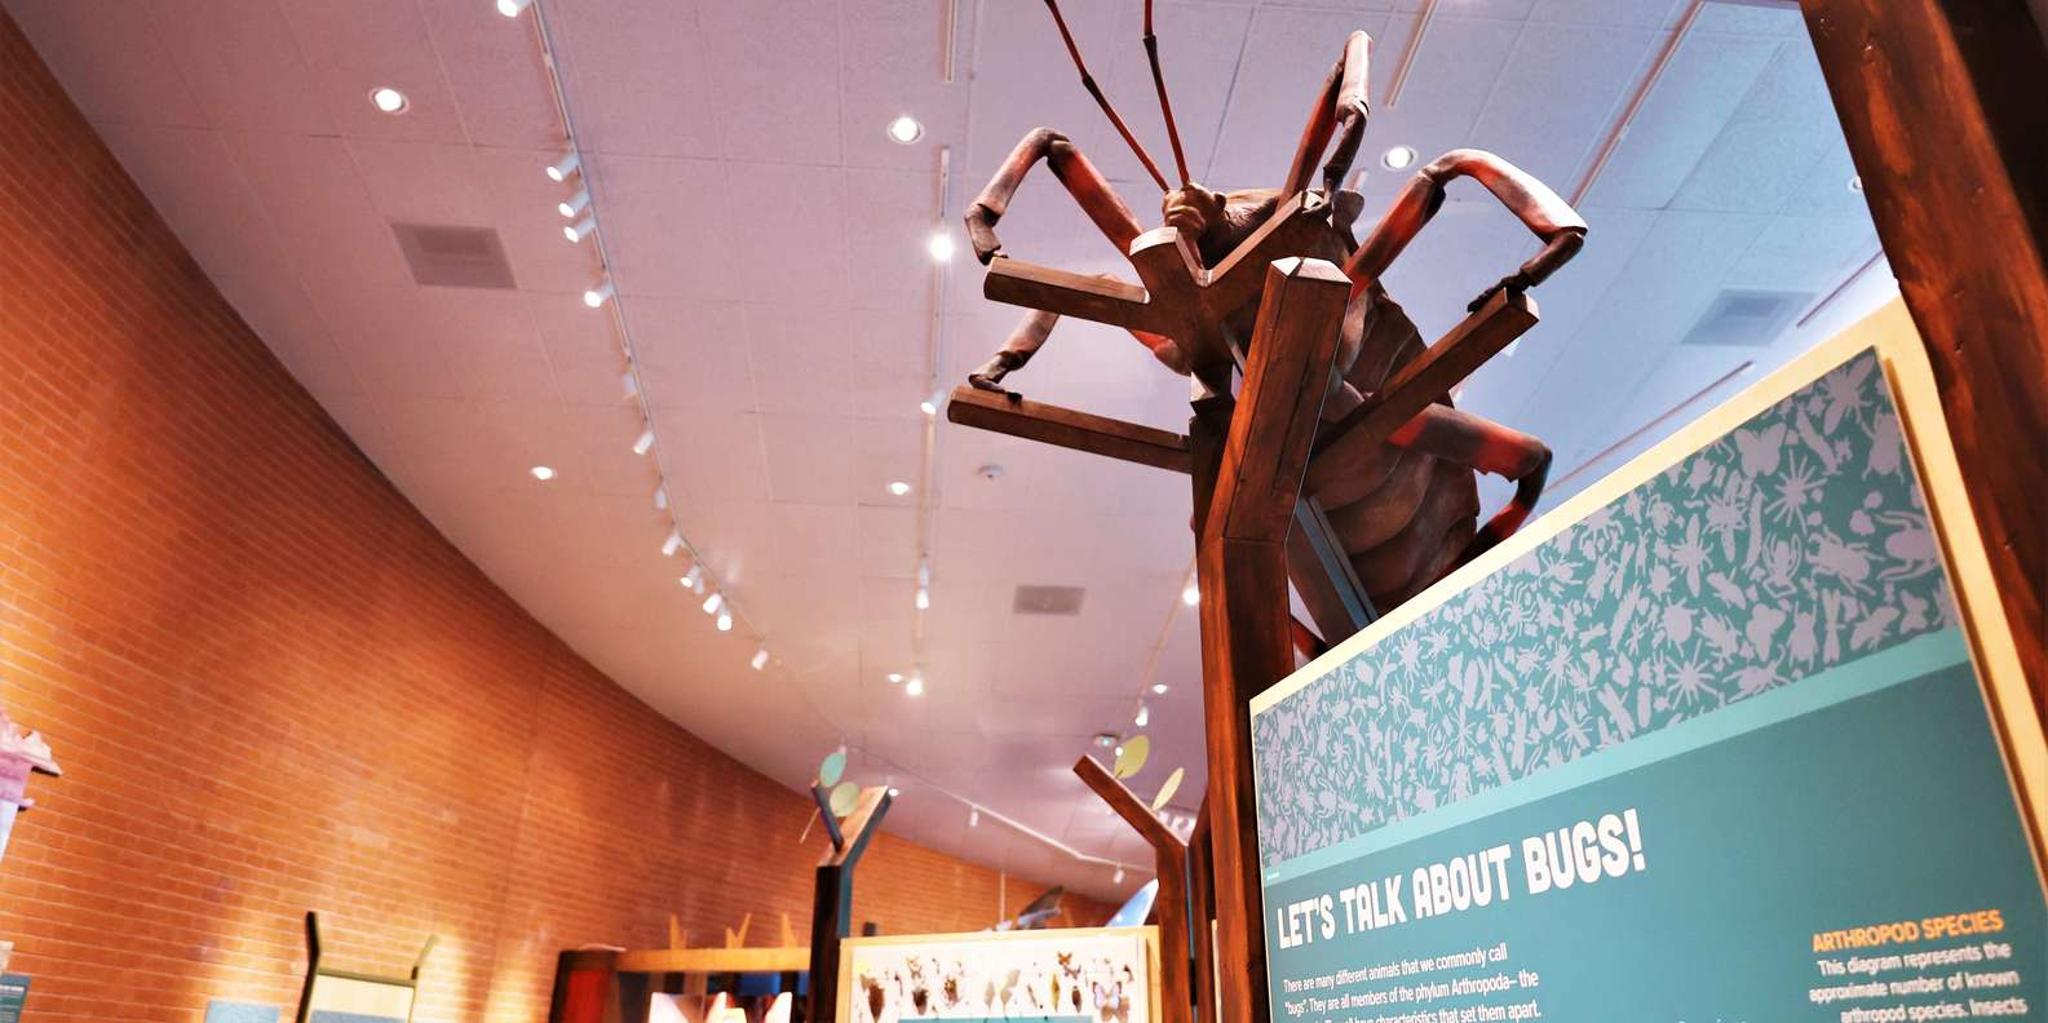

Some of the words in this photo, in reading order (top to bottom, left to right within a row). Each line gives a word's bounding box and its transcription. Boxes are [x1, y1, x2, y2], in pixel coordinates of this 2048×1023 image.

[1277, 894, 1336, 949] LET'S
[1340, 875, 1408, 934] TALK
[1412, 844, 1512, 919] ABOUT
[1522, 808, 1647, 895] BUGS!
[1812, 921, 1920, 952] ARTHROPOD
[1921, 909, 2004, 939] SPECIES
[1283, 978, 1302, 993] There
[1303, 979, 1315, 990] are
[1315, 974, 1335, 990] many
[1335, 967, 1368, 986] different
[1368, 961, 1400, 980] animals
[1400, 958, 1419, 976] that
[1419, 958, 1435, 972] we
[1435, 946, 1487, 969] commonly
[1488, 942, 1508, 962] call
[1816, 958, 1847, 977] This
[1847, 956, 1903, 976] diagram
[1903, 945, 1983, 970] represents
[1983, 941, 2012, 960] the
[1309, 997, 1327, 1015] They
[1327, 998, 1340, 1011] are
[1340, 993, 1350, 1009] all
[1351, 990, 1388, 1007] members
[1389, 987, 1398, 1003] of
[1398, 984, 1414, 1001] the
[1415, 981, 1450, 1004] phylum
[1518, 968, 1540, 988] the
[1808, 981, 1889, 1005] approximate
[1889, 976, 1945, 995] number
[1946, 971, 1963, 991] of
[1963, 970, 2021, 990] known
[1438, 1006, 1459, 1023] that
[1459, 1005, 1476, 1021] set
[1477, 1003, 1506, 1021] them
[1507, 999, 1542, 1023] apart.
[1907, 1001, 1969, 1023] species.
[1969, 997, 2029, 1017] Insects
